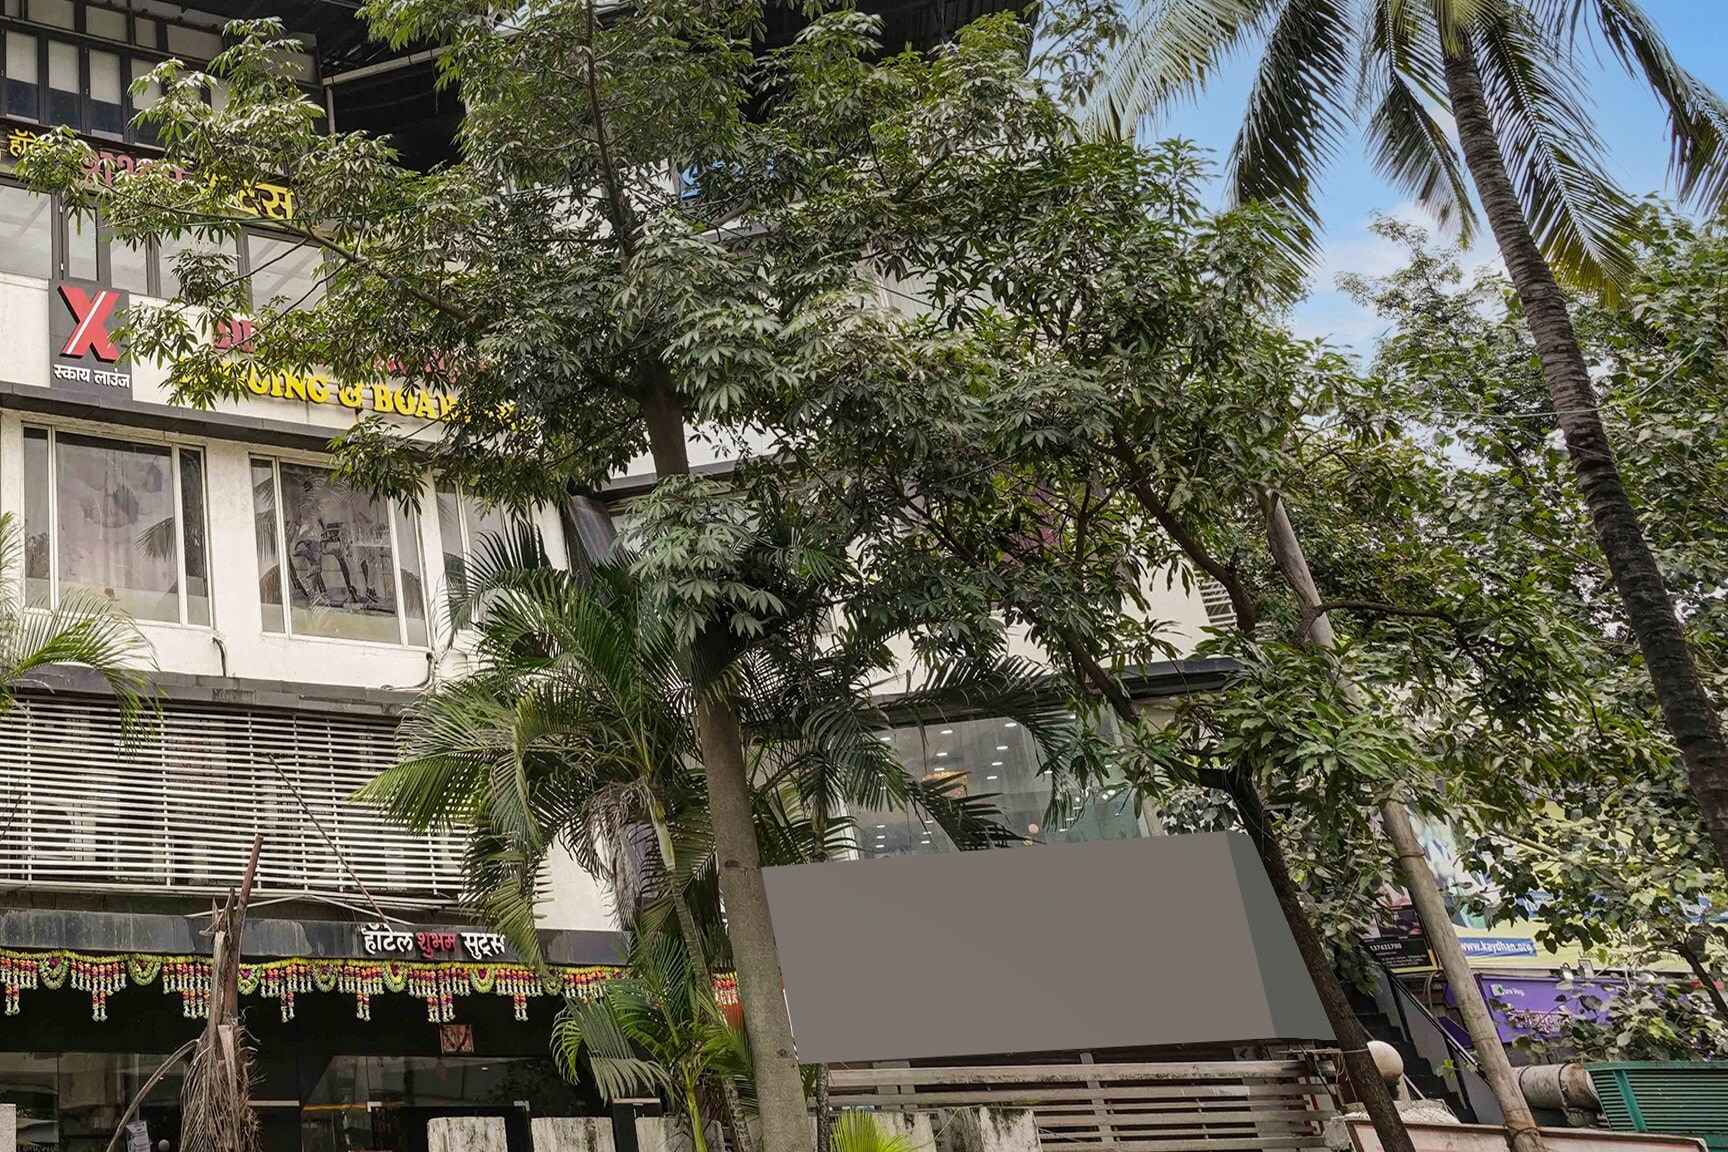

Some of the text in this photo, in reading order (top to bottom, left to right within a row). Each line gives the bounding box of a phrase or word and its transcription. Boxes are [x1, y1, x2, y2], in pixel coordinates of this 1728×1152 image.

[57, 285, 120, 363] X
[53, 364, 130, 387] स्काय लाउंज
[361, 923, 414, 955] हॉटेल
[416, 932, 458, 958] शुभम
